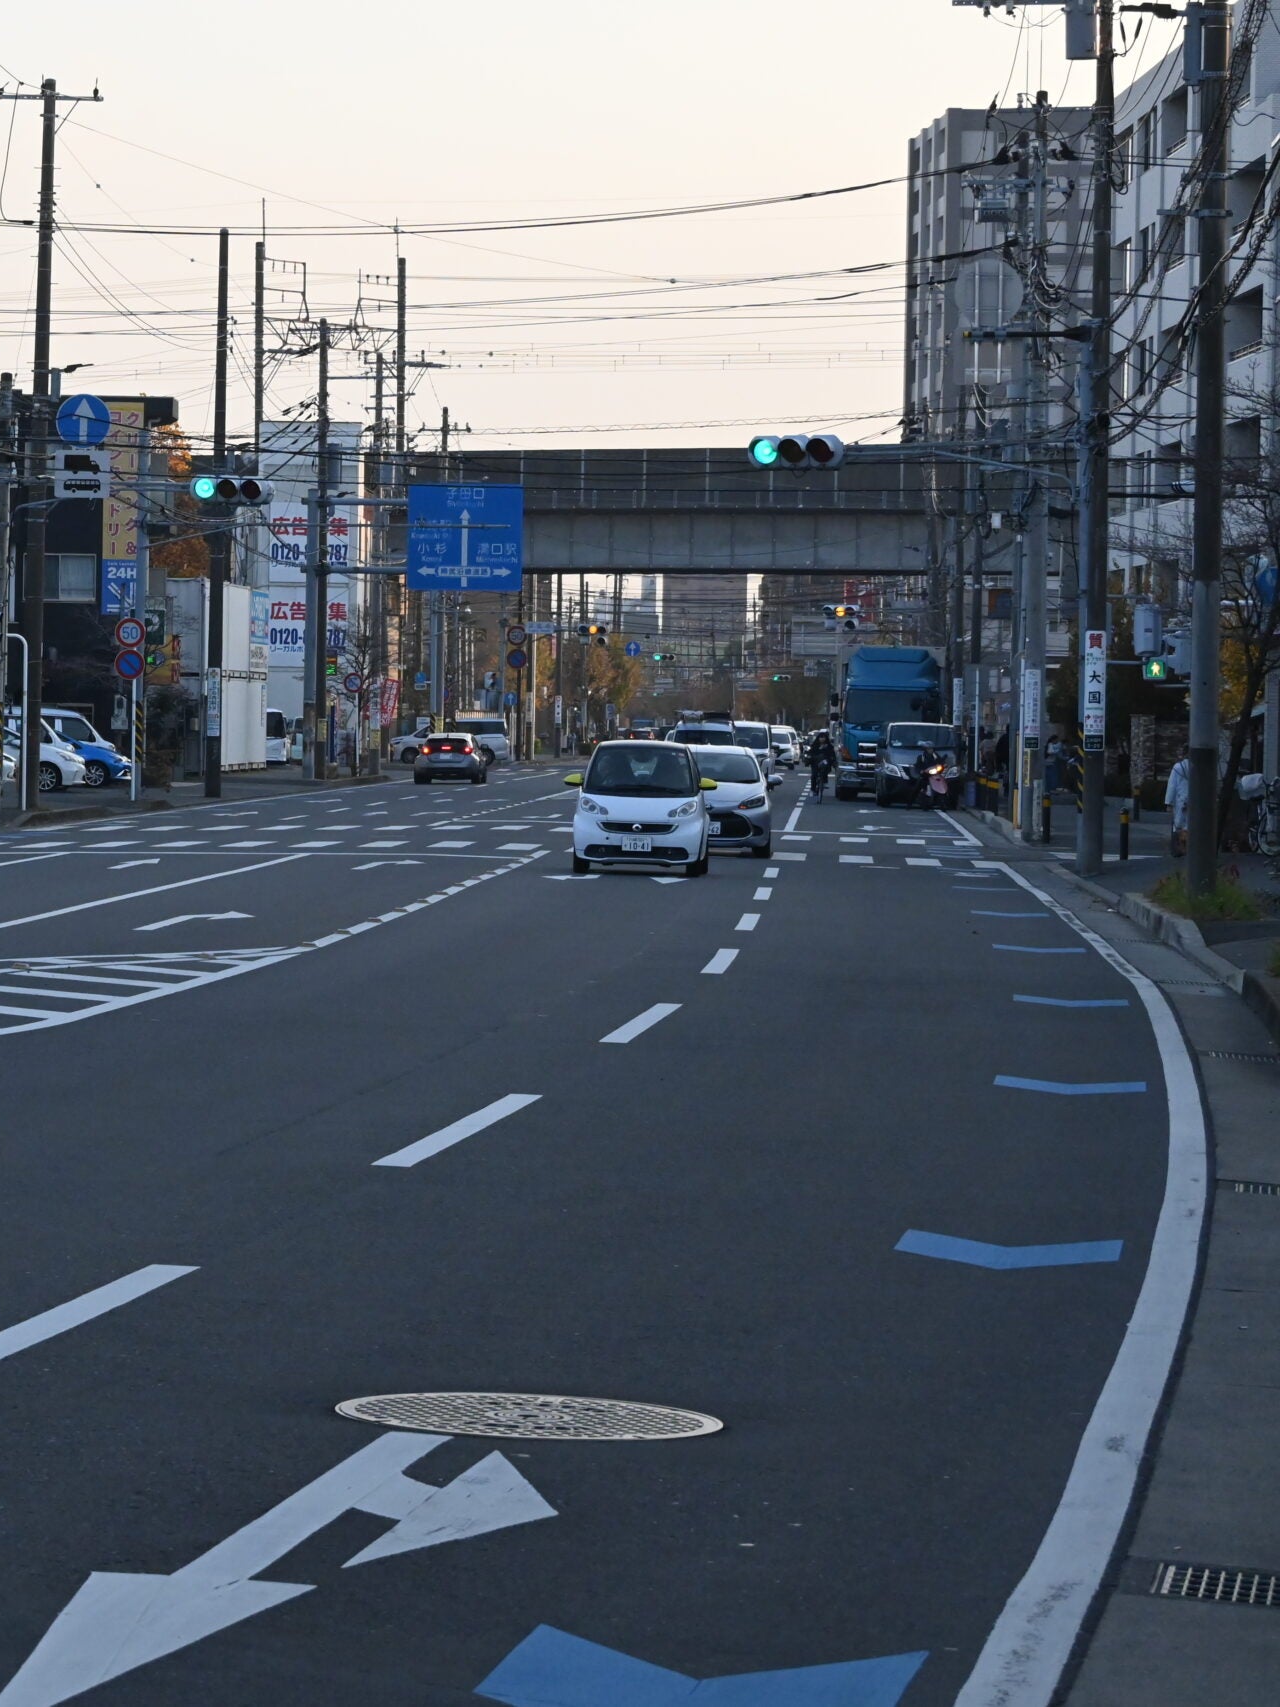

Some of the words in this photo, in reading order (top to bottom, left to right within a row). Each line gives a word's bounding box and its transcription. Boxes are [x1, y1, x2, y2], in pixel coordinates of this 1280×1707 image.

[272, 516, 348, 537] 広告集
[417, 543, 448, 554] 小杉
[271, 602, 347, 621] 広告集
[122, 626, 138, 639] 50
[1089, 633, 1103, 648] 質
